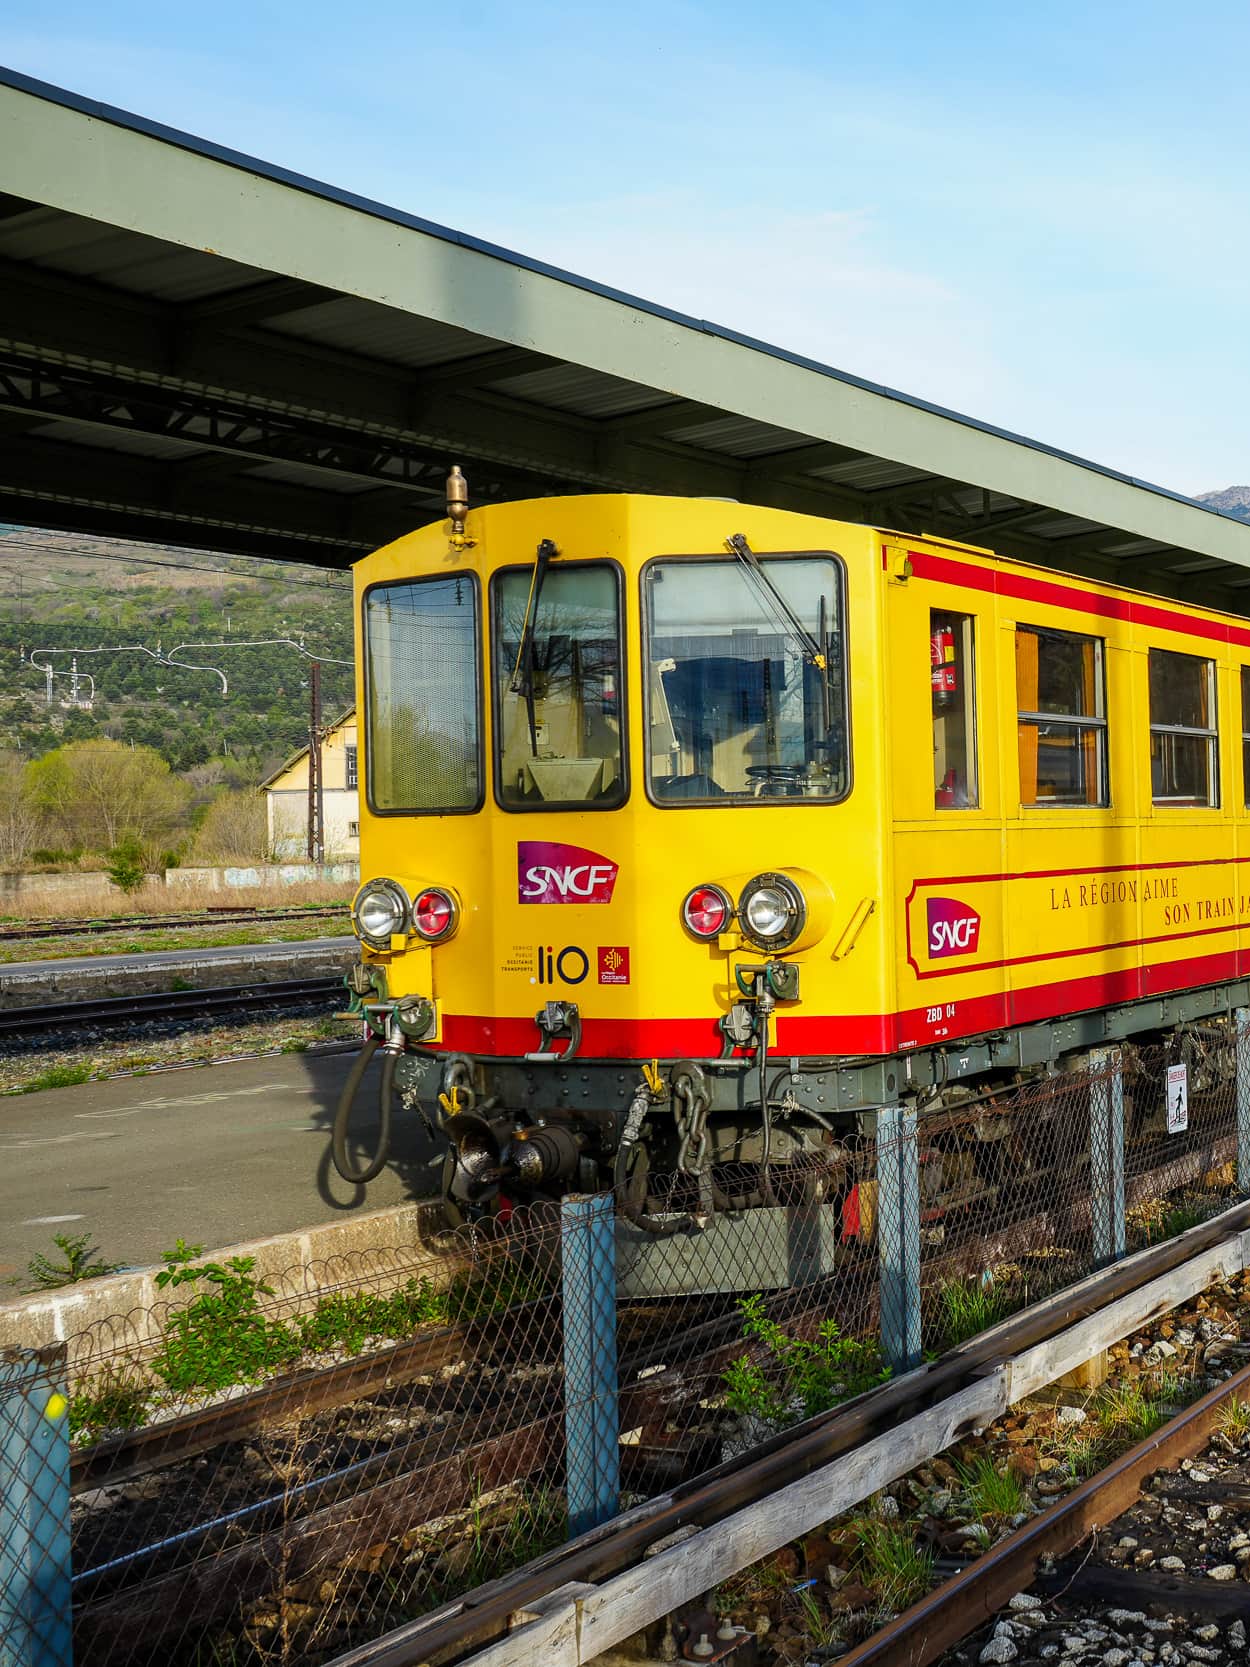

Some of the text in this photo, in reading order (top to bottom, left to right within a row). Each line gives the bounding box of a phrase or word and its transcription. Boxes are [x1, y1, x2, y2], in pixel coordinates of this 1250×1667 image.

[522, 865, 613, 896] SNCF
[1050, 877, 1178, 910] LA RÉGION AIME
[1164, 903, 1190, 926] SON
[1197, 896, 1234, 921] TRAIN
[930, 917, 978, 951] SNCF
[926, 1003, 955, 1024] ZBD 04
